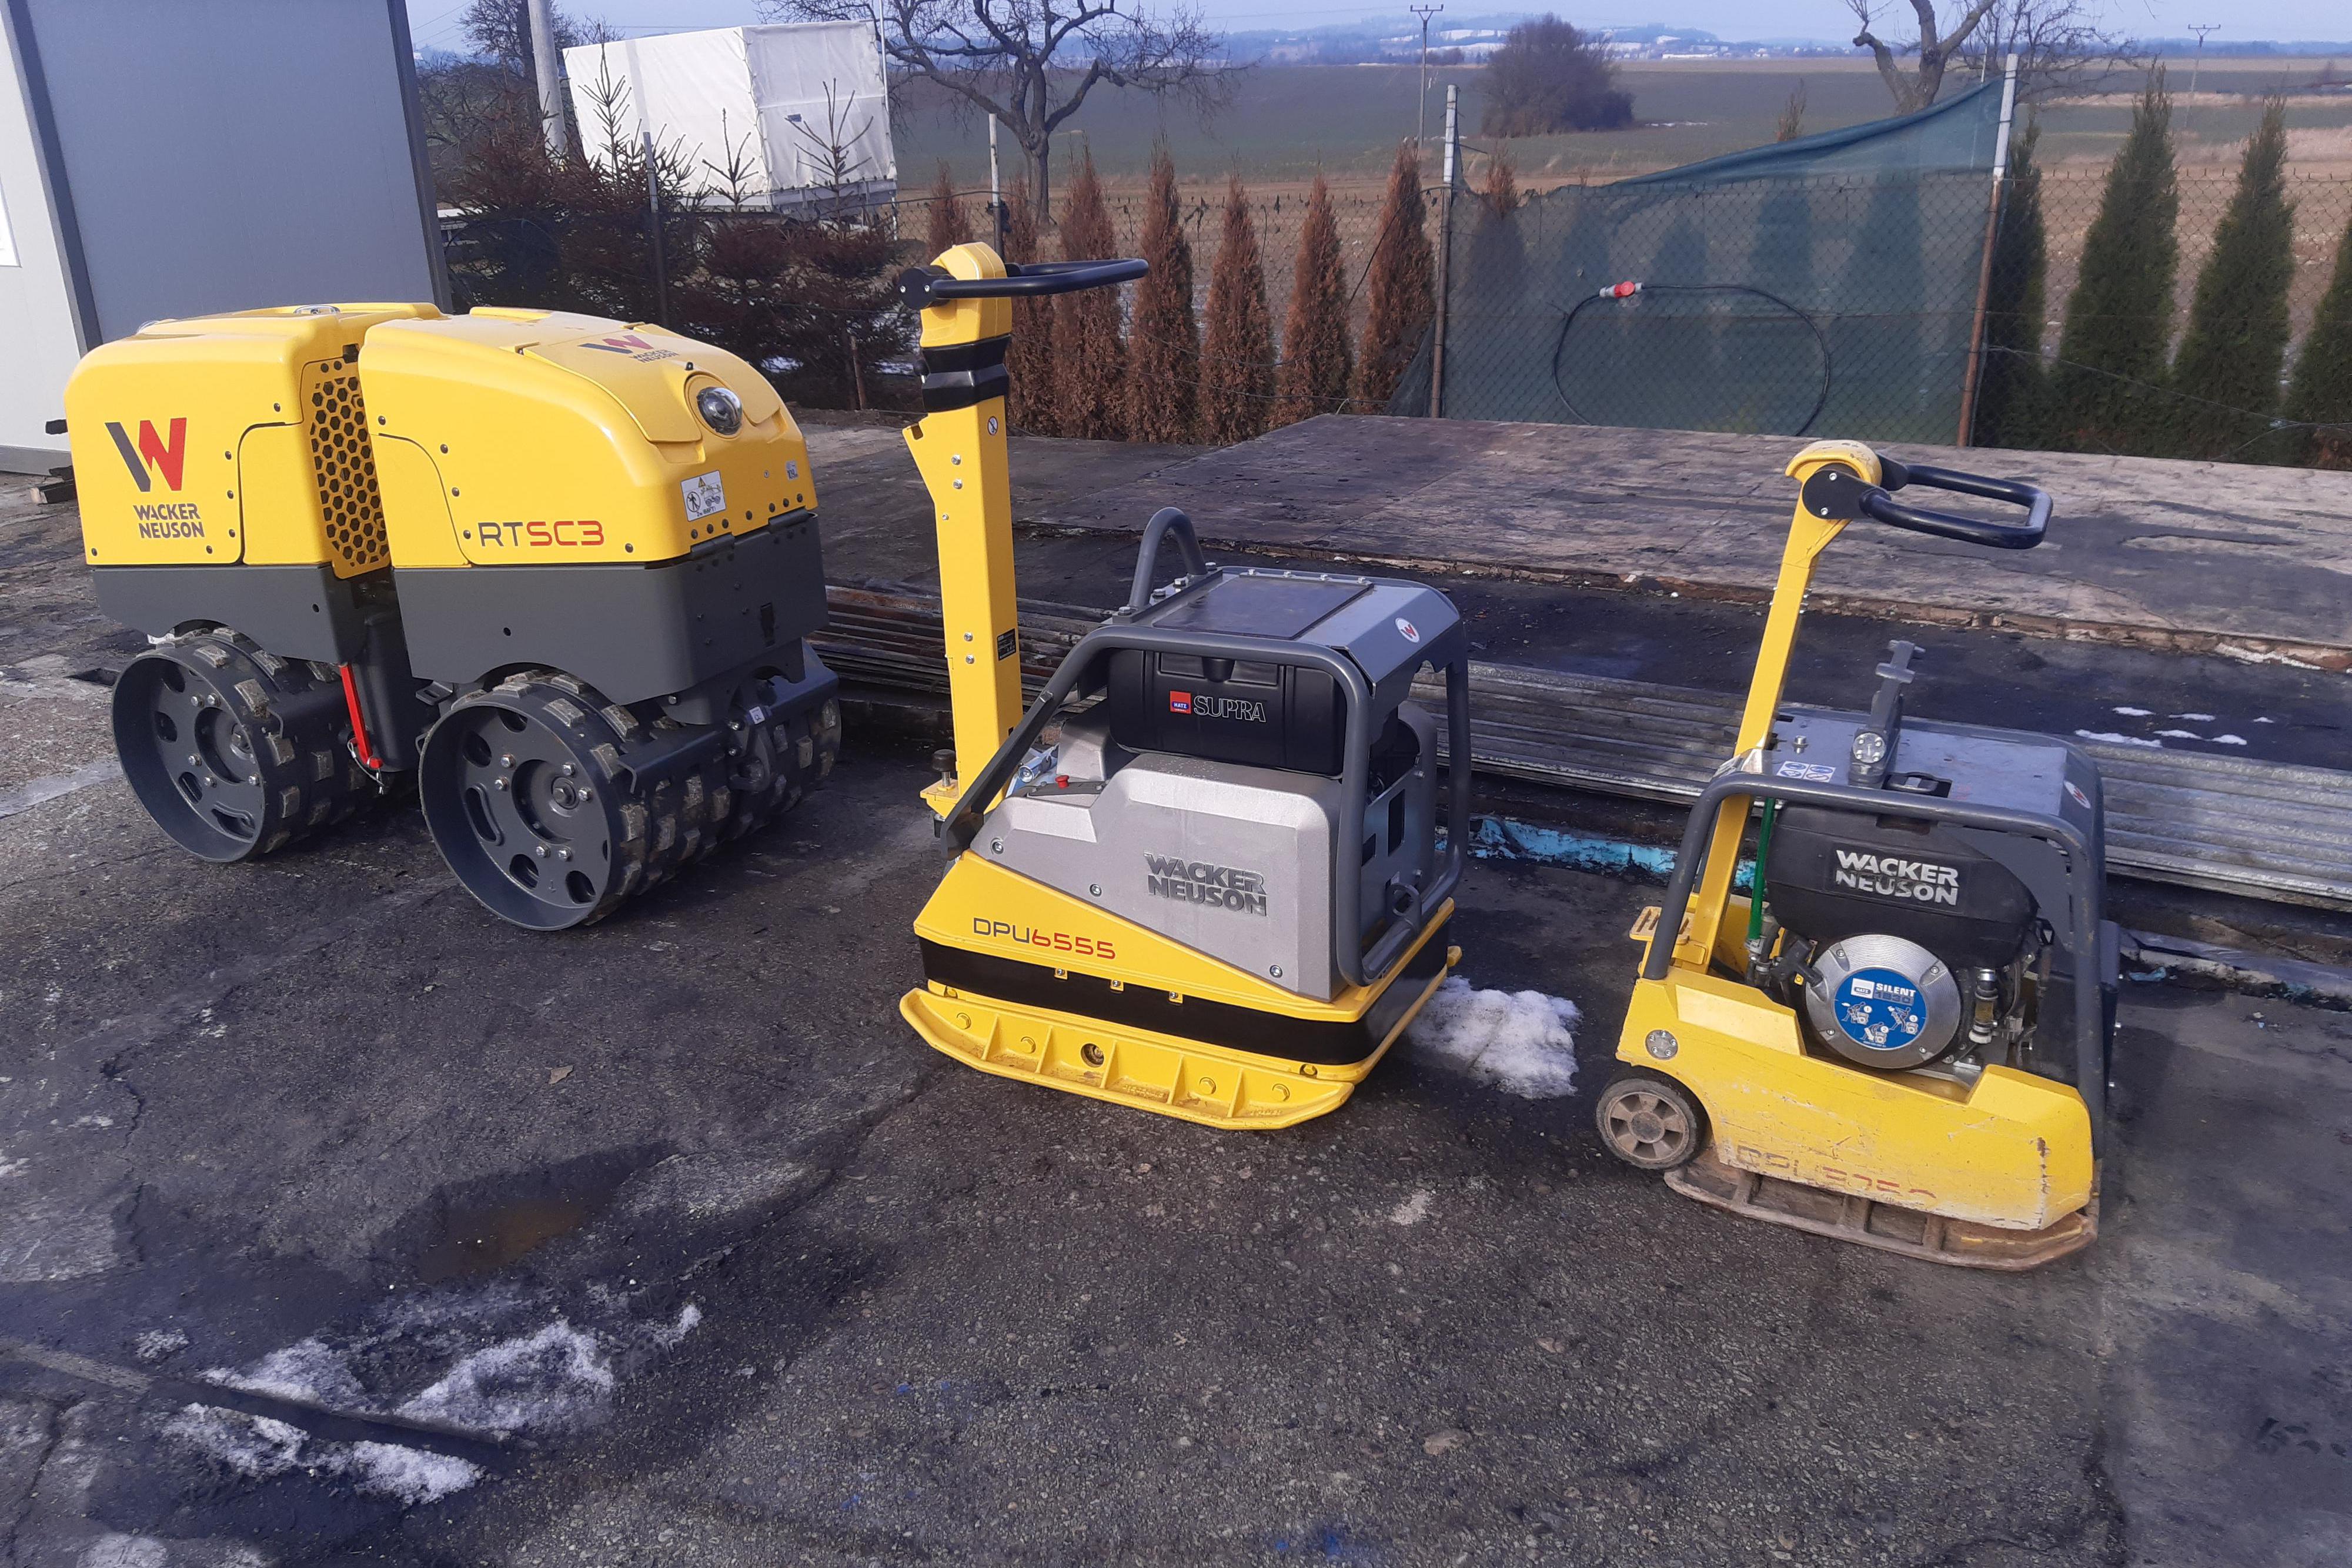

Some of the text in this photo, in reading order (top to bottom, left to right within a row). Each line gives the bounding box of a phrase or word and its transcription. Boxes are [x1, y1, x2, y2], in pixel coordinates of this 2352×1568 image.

[133, 503, 201, 520] WACKER
[139, 521, 205, 539] NEUSON
[478, 520, 604, 547] RTSC3
[1194, 696, 1266, 723] SUPRA
[1144, 852, 1267, 896] WACKER
[1836, 850, 1959, 887] WACKER
[1148, 874, 1267, 917] NEUSON
[1836, 870, 1958, 906] NEUSON
[974, 918, 1116, 960] DPU6555
[1876, 983, 1916, 997] SILENT
